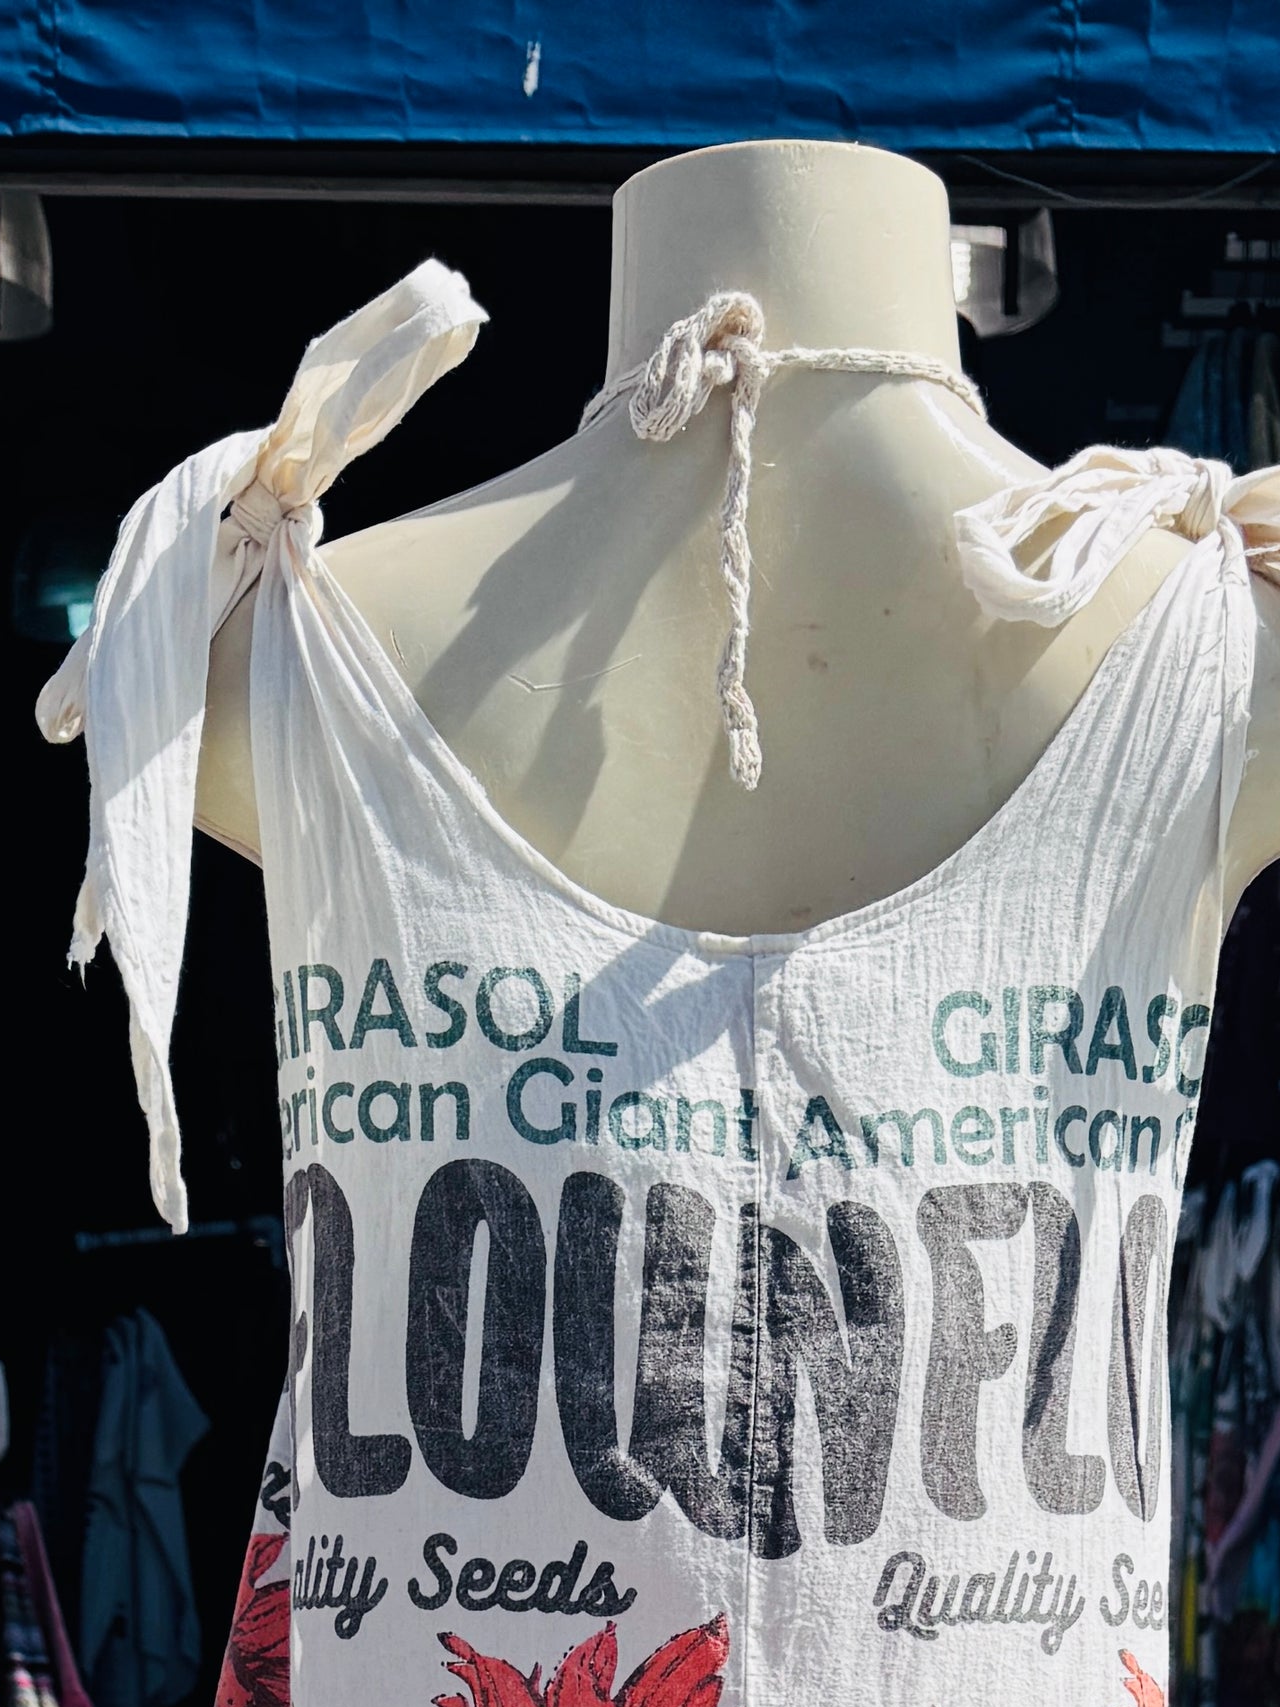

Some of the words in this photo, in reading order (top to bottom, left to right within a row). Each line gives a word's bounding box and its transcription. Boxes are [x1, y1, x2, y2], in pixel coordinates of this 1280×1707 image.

[506, 1056, 759, 1163] Giant
[786, 1094, 1162, 1181] American
[407, 1532, 637, 1617] Seeds
[872, 1550, 1086, 1656] Quality
